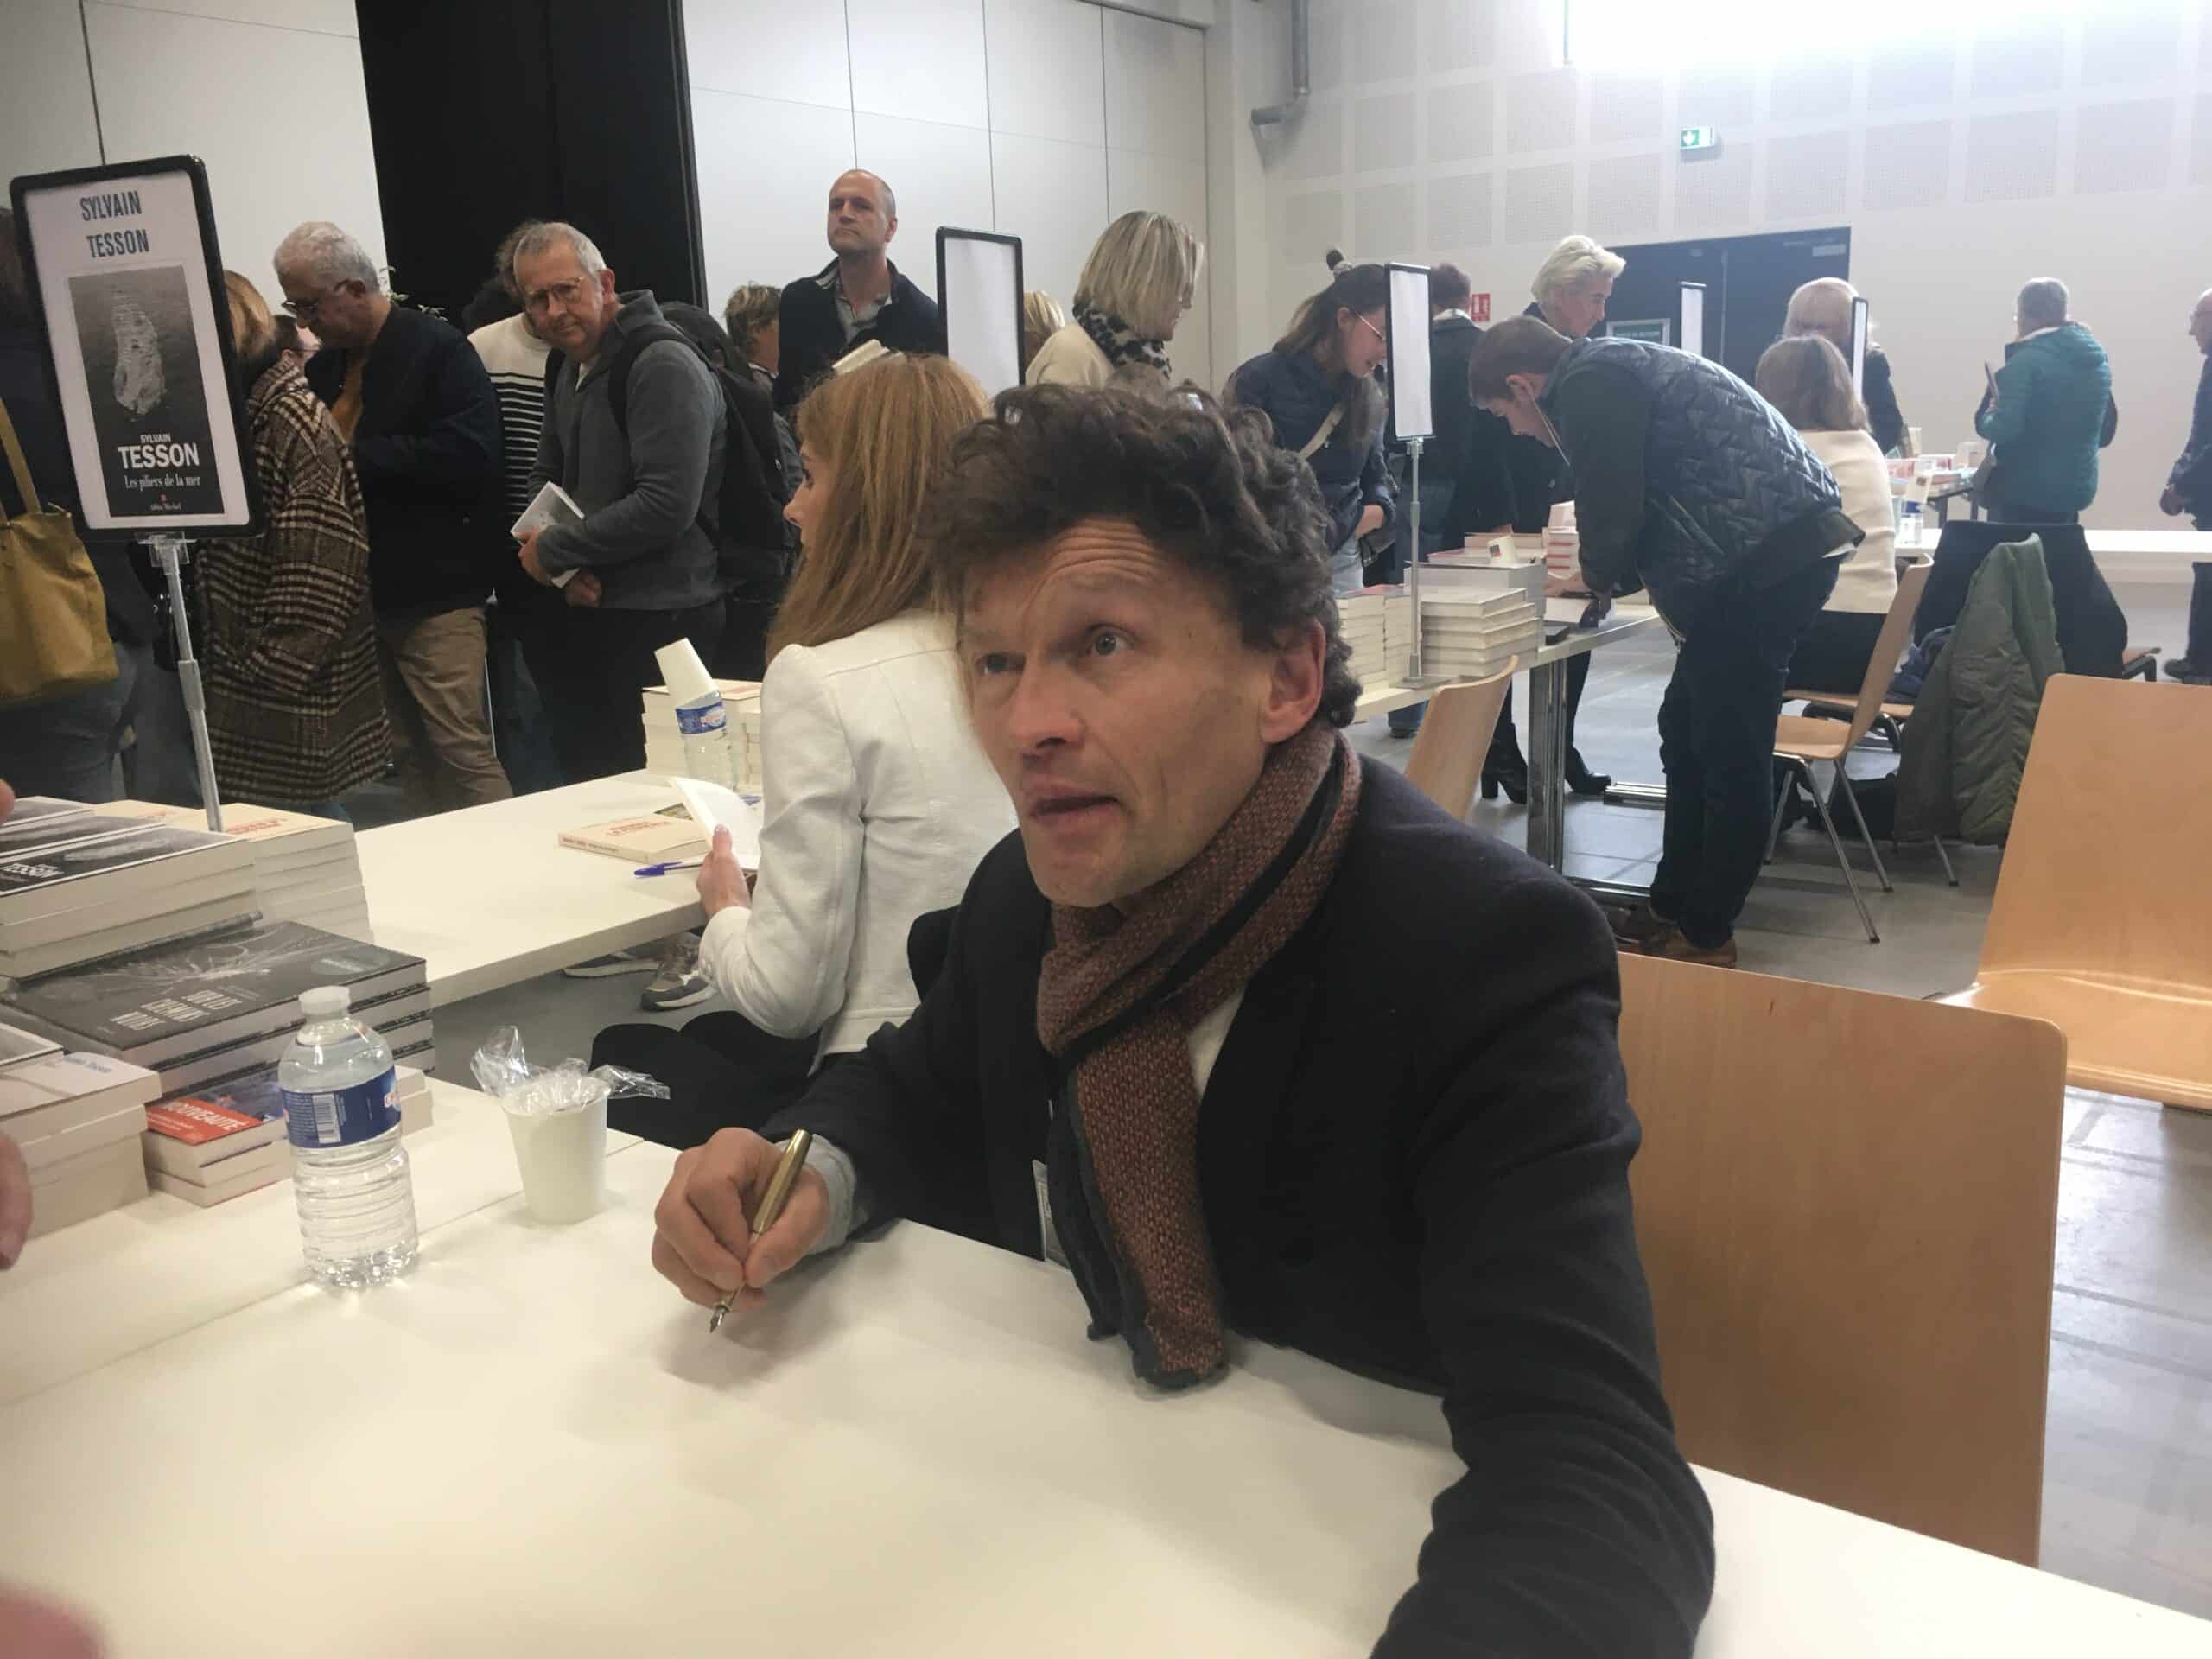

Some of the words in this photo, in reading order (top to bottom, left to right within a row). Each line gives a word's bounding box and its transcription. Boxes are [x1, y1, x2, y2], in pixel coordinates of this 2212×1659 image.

[80, 190, 142, 221] SYLVAIN
[86, 228, 149, 258] TESSON
[140, 433, 172, 443] SYLVAIN
[117, 442, 200, 469] TESSON
[124, 475, 137, 489] Les
[164, 473, 174, 486] de
[175, 473, 184, 486] la
